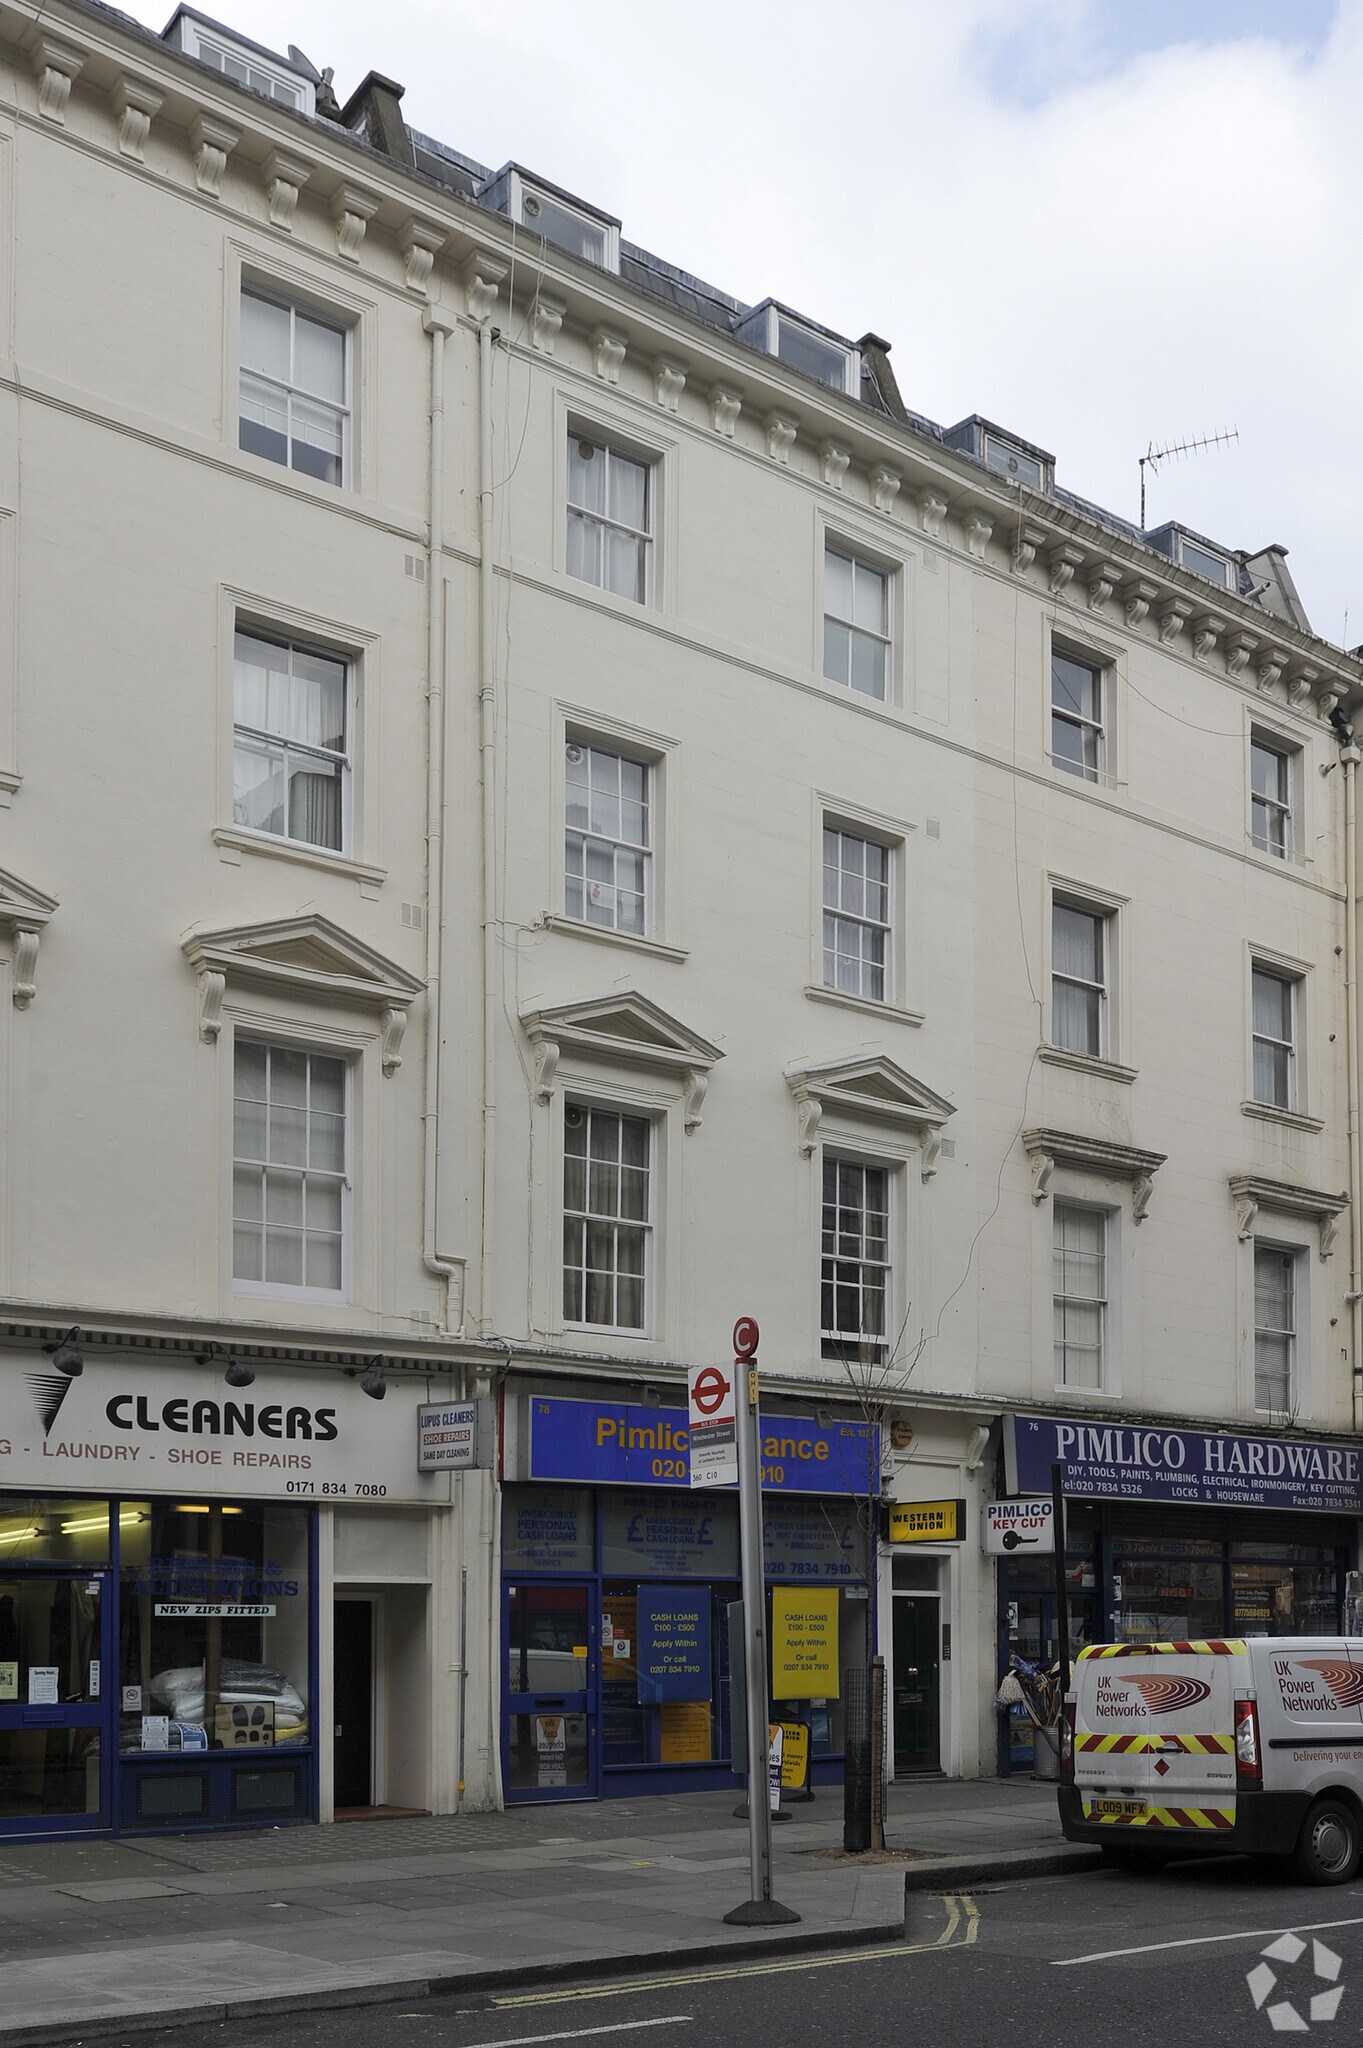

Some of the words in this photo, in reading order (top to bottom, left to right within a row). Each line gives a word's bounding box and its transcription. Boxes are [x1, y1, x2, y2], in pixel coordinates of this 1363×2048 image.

[538, 1404, 550, 1415] 78
[105, 1394, 339, 1441] CLEANERS
[420, 1413, 441, 1428] LUPUS
[442, 1410, 475, 1426] CLEANERS
[1028, 1422, 1039, 1431] 76
[424, 1434, 442, 1444] SHOE
[443, 1430, 470, 1442] REPAIRS
[596, 1417, 689, 1452] Pimlic
[693, 1433, 715, 1441] Winchester
[715, 1430, 731, 1438] Street
[42, 1441, 140, 1461] LAUNDRY
[168, 1448, 222, 1465] SHOE
[233, 1451, 312, 1470] REPAIRS
[436, 1449, 446, 1459] DAY
[446, 1447, 470, 1458] CLEANING
[1054, 1425, 1186, 1469] PIMLICO
[1203, 1438, 1360, 1482] HARDWARE
[692, 1474, 703, 1482] 360
[706, 1471, 718, 1480] C10
[1067, 1465, 1087, 1477] DIY,
[1088, 1466, 1119, 1479] TOOLS,
[1121, 1469, 1153, 1481] PAINTS,
[1155, 1471, 1200, 1484] PLUMBING,
[1202, 1475, 1249, 1488] ELECTRICAL,
[1251, 1479, 1309, 1493] IRONMONGERY,
[1310, 1483, 1325, 1493] KEY
[1326, 1484, 1358, 1496] CUTTING,
[286, 1480, 315, 1493] 0171
[322, 1482, 347, 1494] 834
[354, 1483, 387, 1496] 7080
[1096, 1482, 1119, 1493] 7834
[1121, 1483, 1142, 1494] 5326
[1171, 1486, 1198, 1498] LOCKS
[1205, 1490, 1212, 1499] &
[1217, 1490, 1264, 1502] HOUSEWARE
[1292, 1495, 1322, 1507] Fax:020
[1324, 1497, 1343, 1508] 7834
[1344, 1498, 1361, 1508] 5341
[517, 1509, 577, 1519] UNSECURED
[892, 1511, 943, 1523] WESTERN
[987, 1503, 1053, 1519] PIMLICO
[517, 1519, 577, 1530] PERSONAL
[646, 1516, 695, 1526] UNSECURED
[909, 1520, 943, 1531] UNION
[993, 1518, 1017, 1530] KEY
[1020, 1517, 1046, 1528] CUT
[627, 1514, 644, 1543] £
[646, 1525, 695, 1535] PERSONAL
[697, 1516, 714, 1545] £
[517, 1530, 544, 1540] CASH
[546, 1531, 577, 1541] LOANS
[646, 1534, 667, 1543] CASH
[668, 1535, 695, 1544] LOANS
[790, 1563, 820, 1574] 7834
[825, 1563, 852, 1575] 7910
[130, 1579, 299, 1597] ALTERATIONS
[160, 1605, 189, 1614] NEW
[195, 1606, 222, 1615] ZIPS
[227, 1606, 270, 1615] FITTED
[650, 1613, 672, 1622] CASH
[673, 1613, 699, 1622] LOANS
[785, 1614, 803, 1622] CASH
[805, 1614, 828, 1622] LOANS
[654, 1623, 671, 1632] £100
[678, 1623, 696, 1632] £500
[788, 1623, 803, 1632] £100
[809, 1623, 825, 1632] £500
[652, 1639, 673, 1649] Apply
[674, 1639, 697, 1648] Within
[786, 1639, 805, 1648] Apply
[805, 1638, 827, 1647] Within
[663, 1655, 673, 1664] Or
[674, 1655, 687, 1664] call
[796, 1653, 805, 1662] Or
[805, 1653, 818, 1662] call
[650, 1665, 667, 1674] 0207
[668, 1665, 682, 1673] 834
[683, 1664, 700, 1673] 7910
[783, 1663, 799, 1672] 0207
[800, 1663, 813, 1671] 834
[813, 1663, 829, 1671] 7910
[1273, 1660, 1293, 1676] UK
[1097, 1676, 1112, 1689] UK
[1278, 1678, 1316, 1694] Power
[1096, 1690, 1130, 1703] Power
[1282, 1694, 1338, 1712] Networks
[1096, 1703, 1147, 1717] Networks
[1293, 1750, 1333, 1763] Delivering
[1334, 1752, 1351, 1763] your
[1125, 1802, 1145, 1814] MFX
